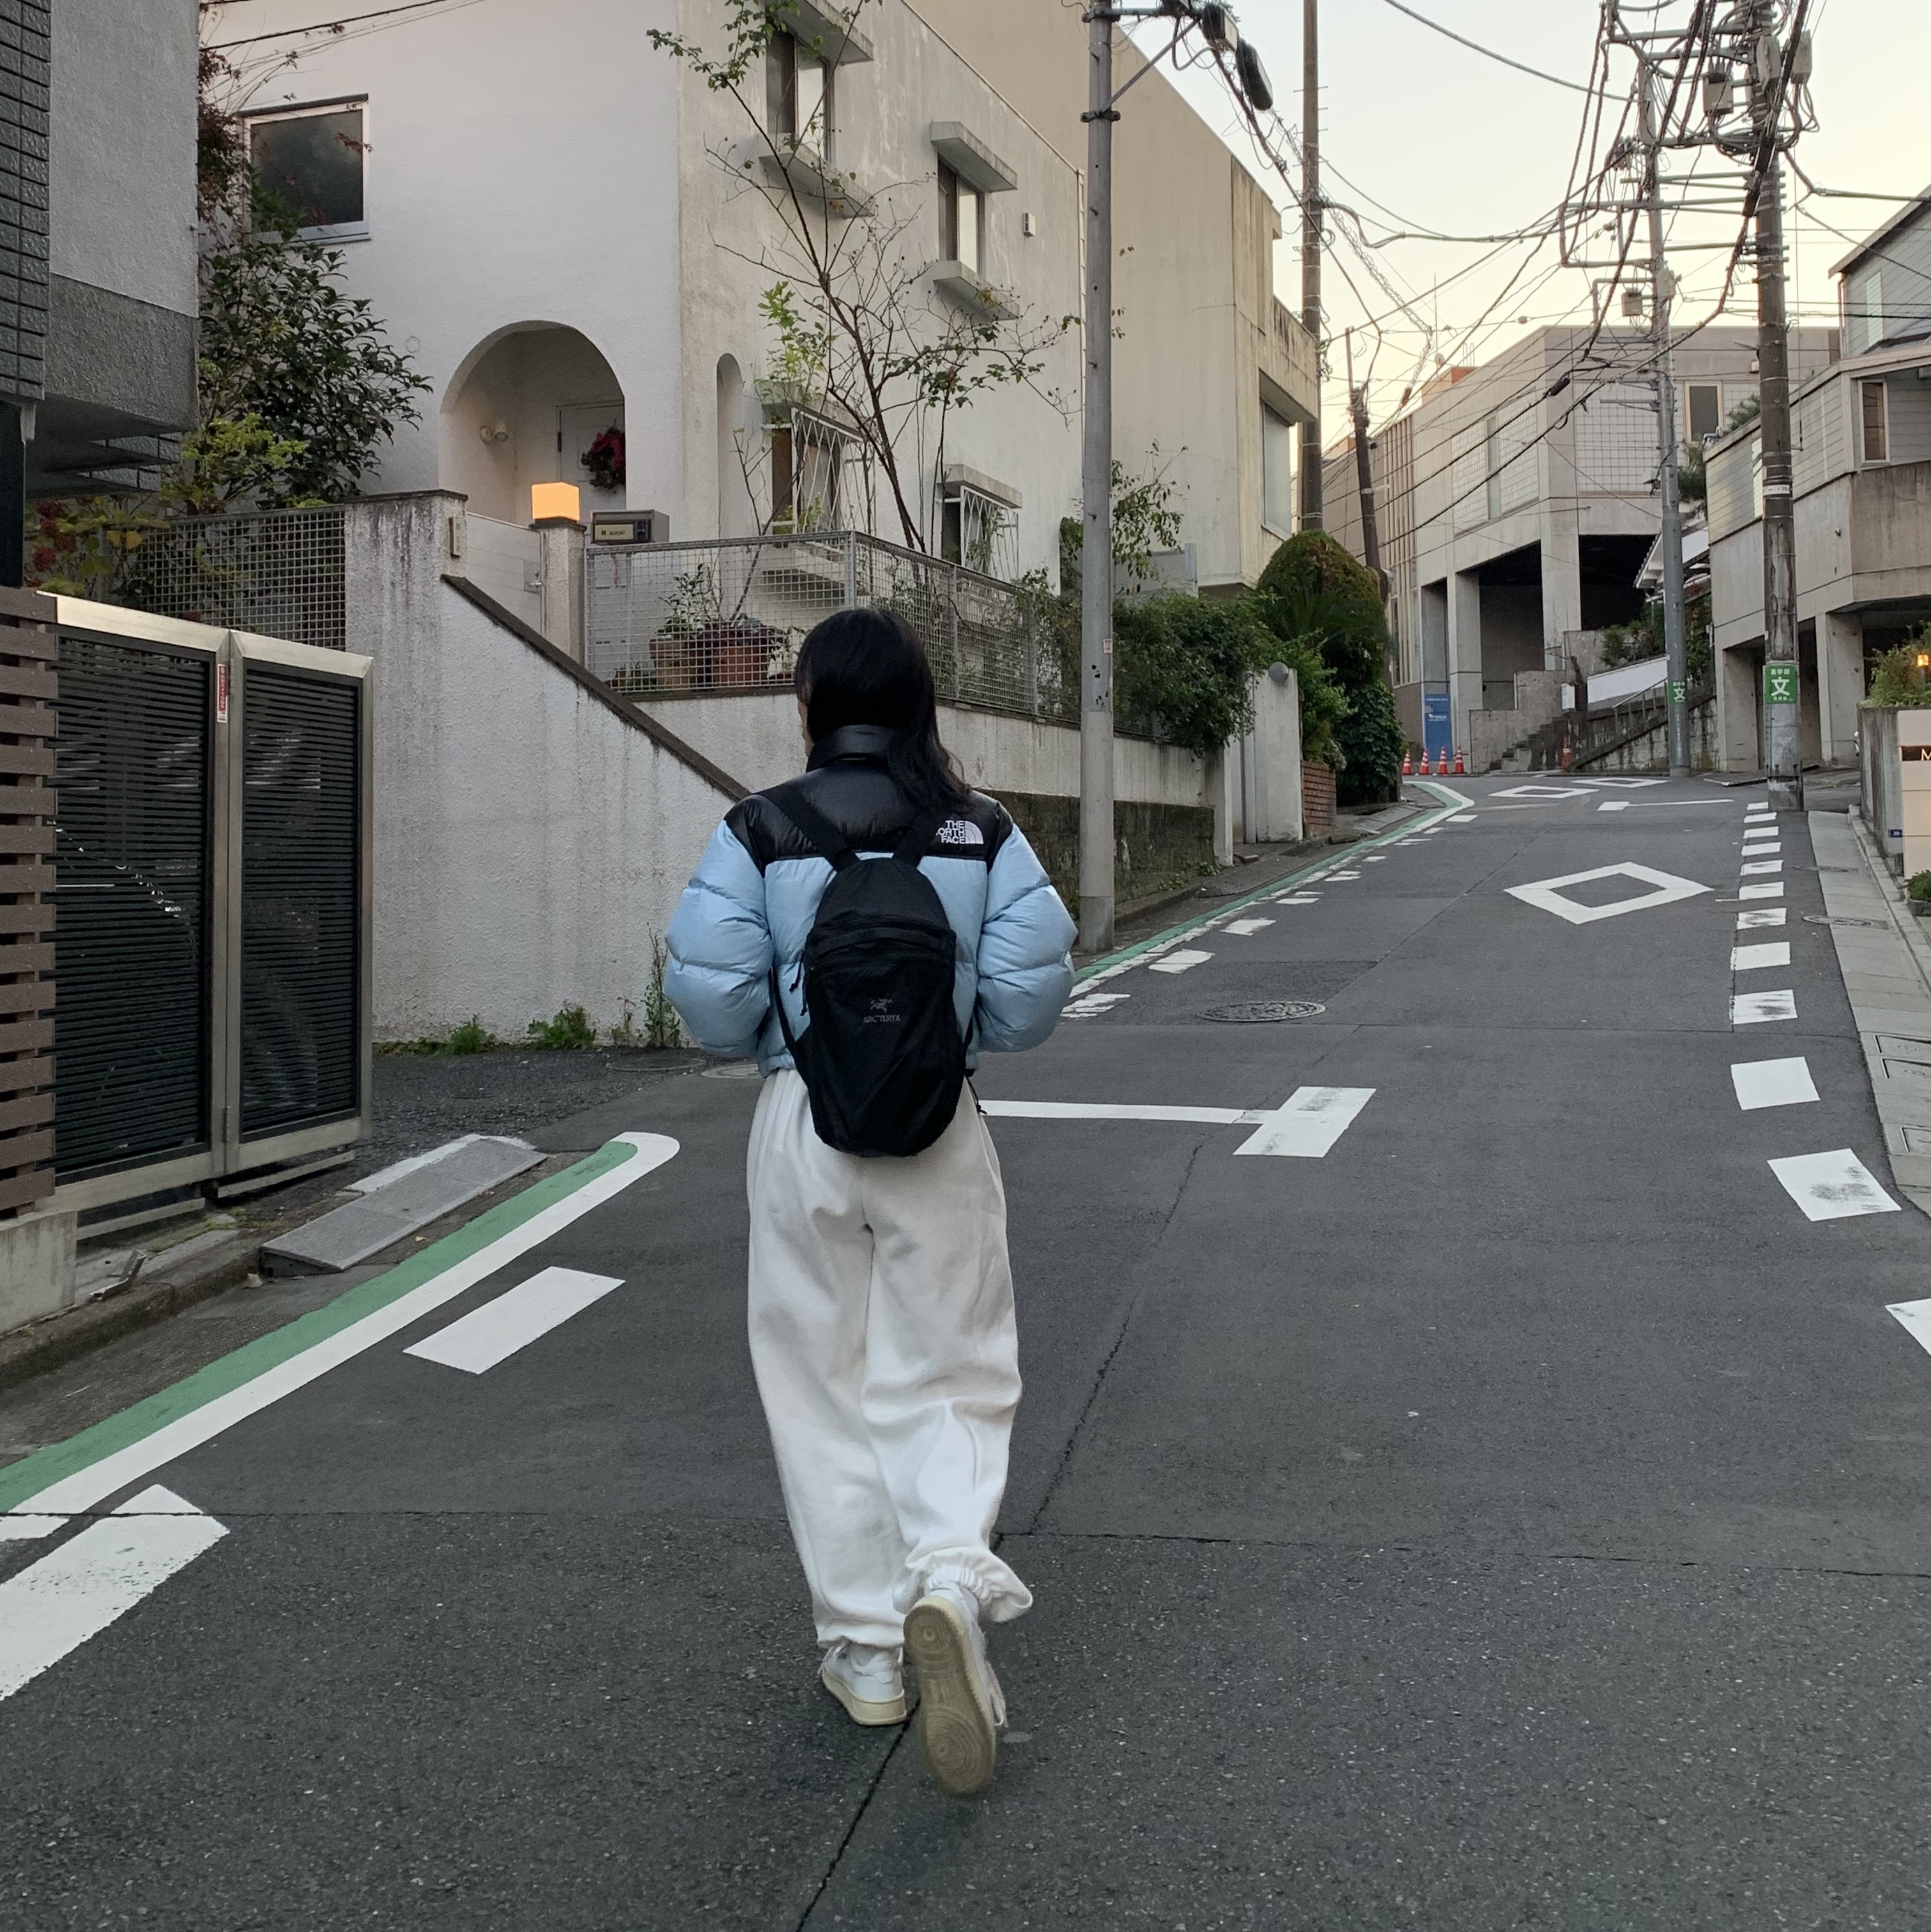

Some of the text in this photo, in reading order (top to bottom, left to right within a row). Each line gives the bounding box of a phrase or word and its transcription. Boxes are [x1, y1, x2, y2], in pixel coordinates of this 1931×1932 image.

[1771, 676, 1790, 696] 文
[1674, 687, 1686, 699] 文
[945, 820, 965, 828] THE
[935, 828, 965, 836] ORTH
[941, 835, 966, 844] FACE
